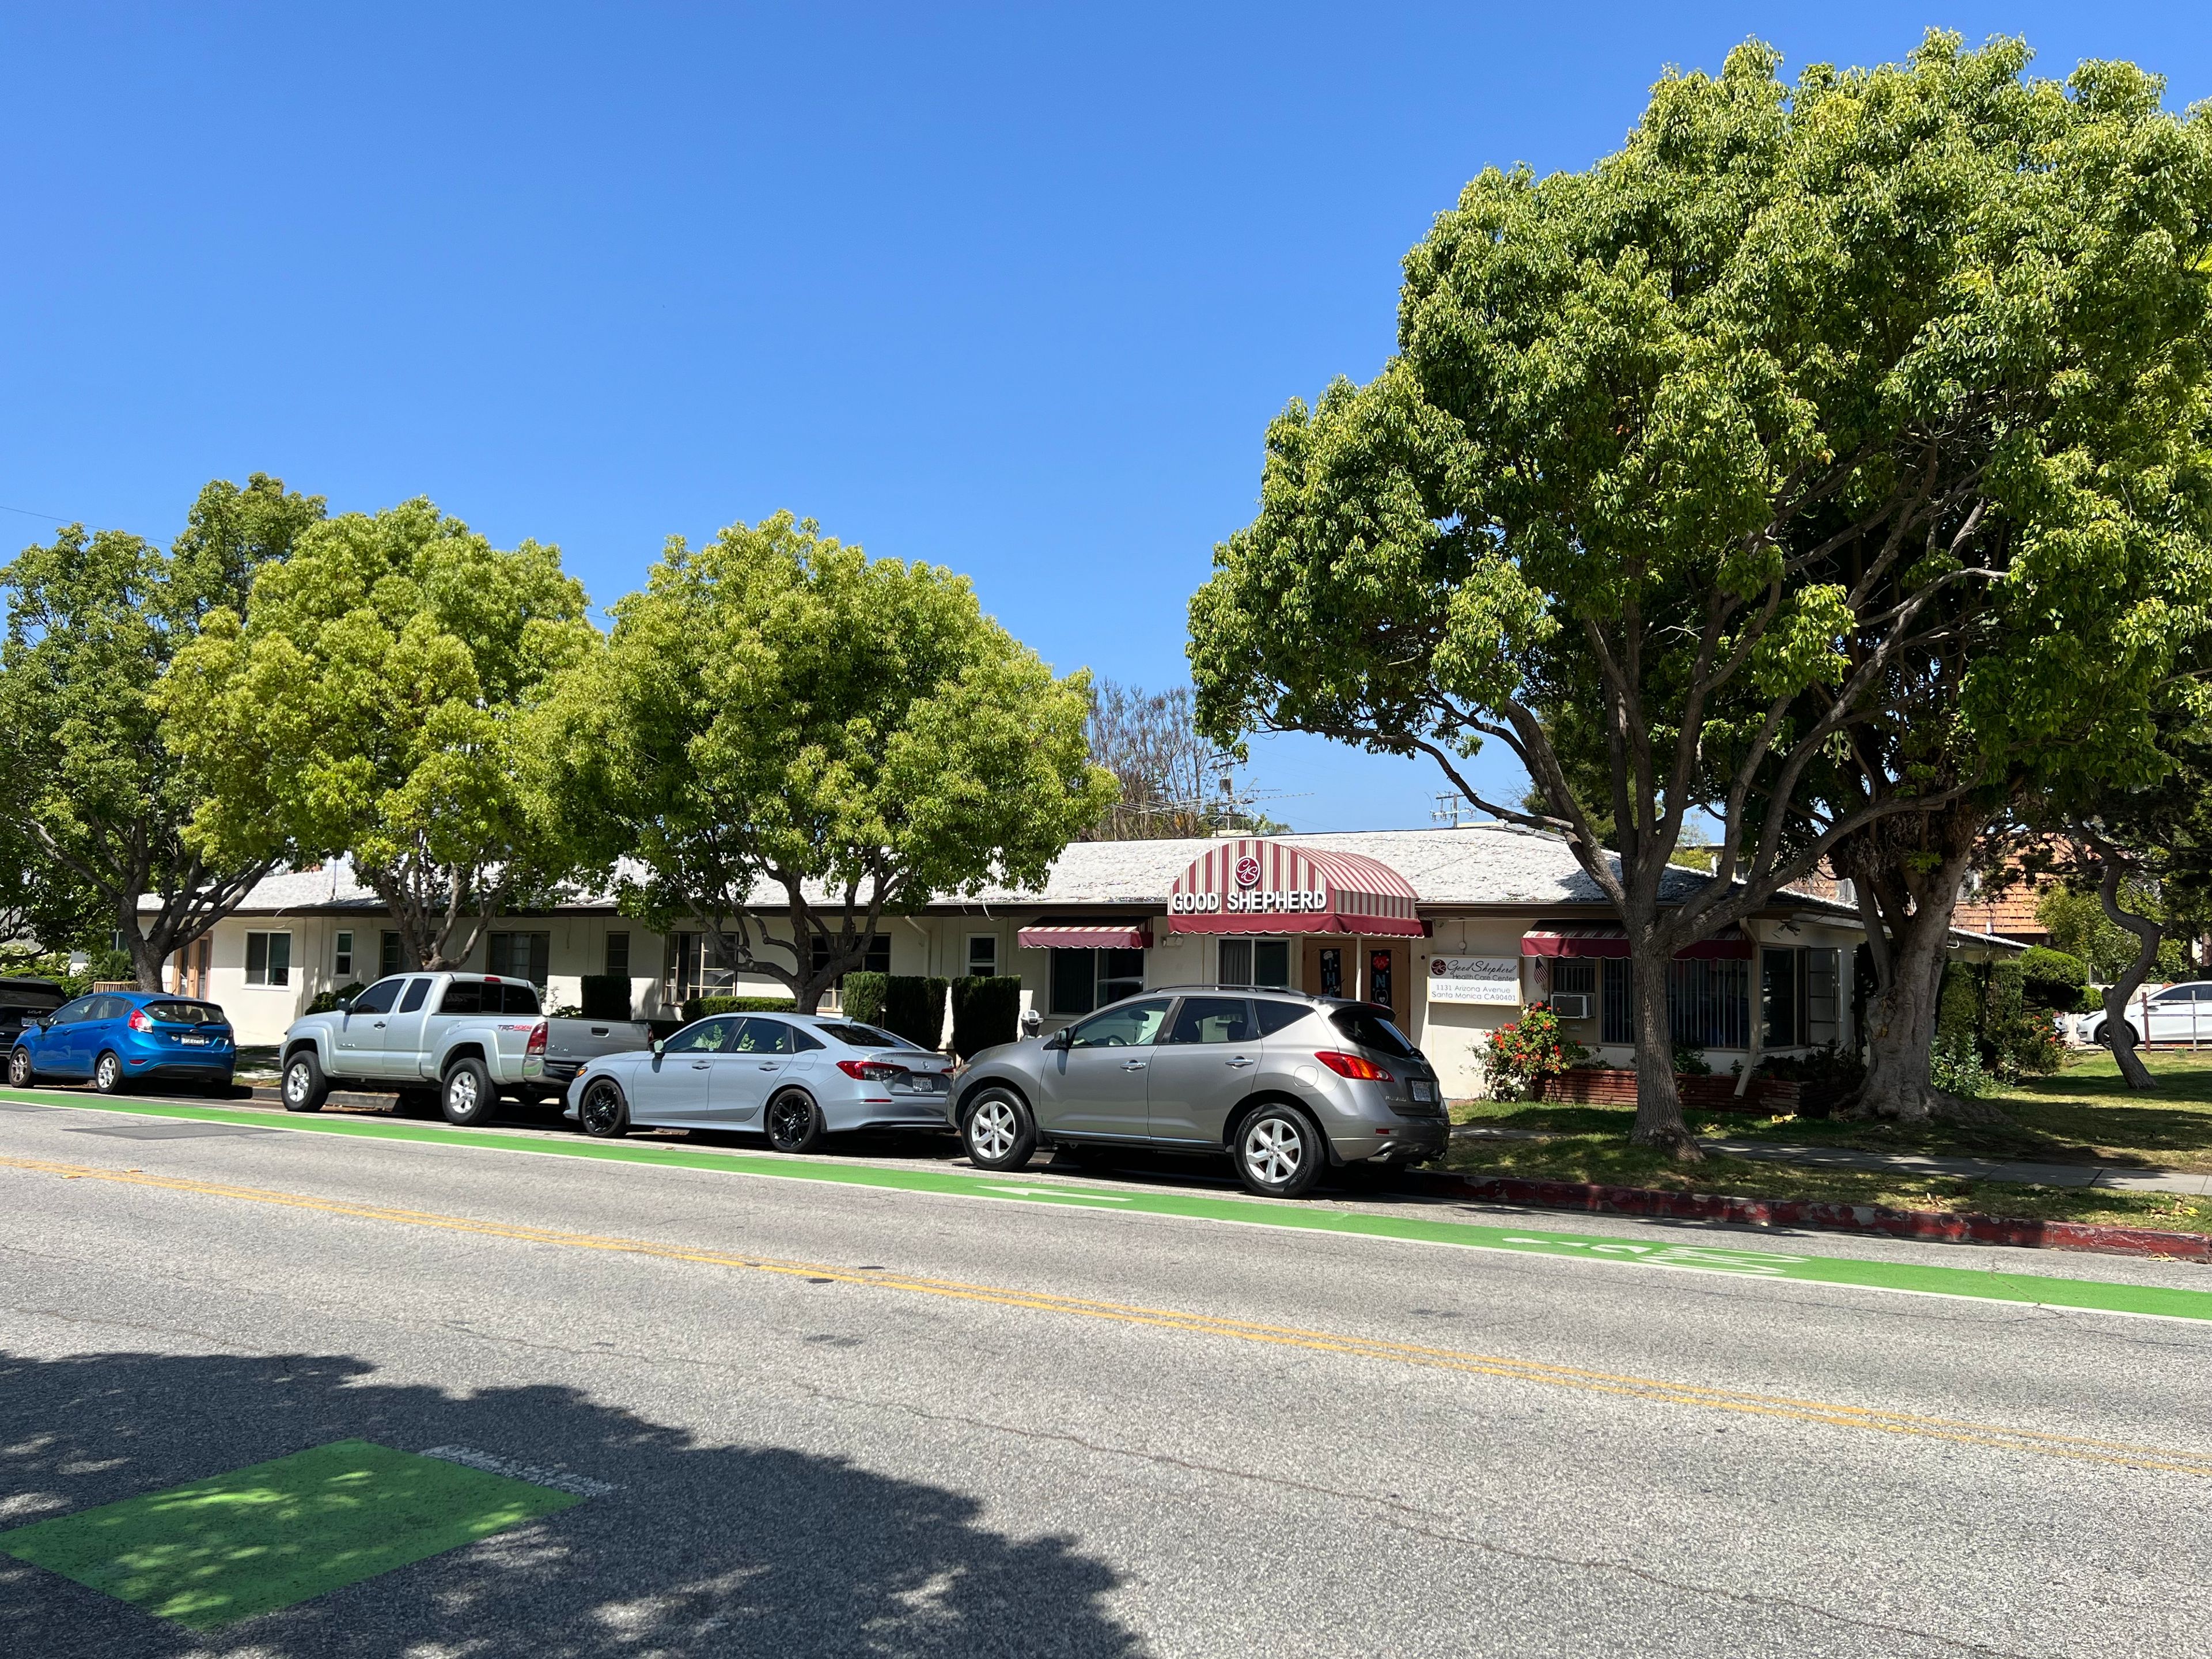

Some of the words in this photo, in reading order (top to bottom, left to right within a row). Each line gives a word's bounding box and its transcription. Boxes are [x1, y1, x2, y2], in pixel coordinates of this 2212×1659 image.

[1172, 892, 1219, 911] GOOD
[1227, 891, 1327, 910] SHEPHERD
[1447, 960, 1474, 975] Good
[1471, 960, 1517, 975] Shepherd
